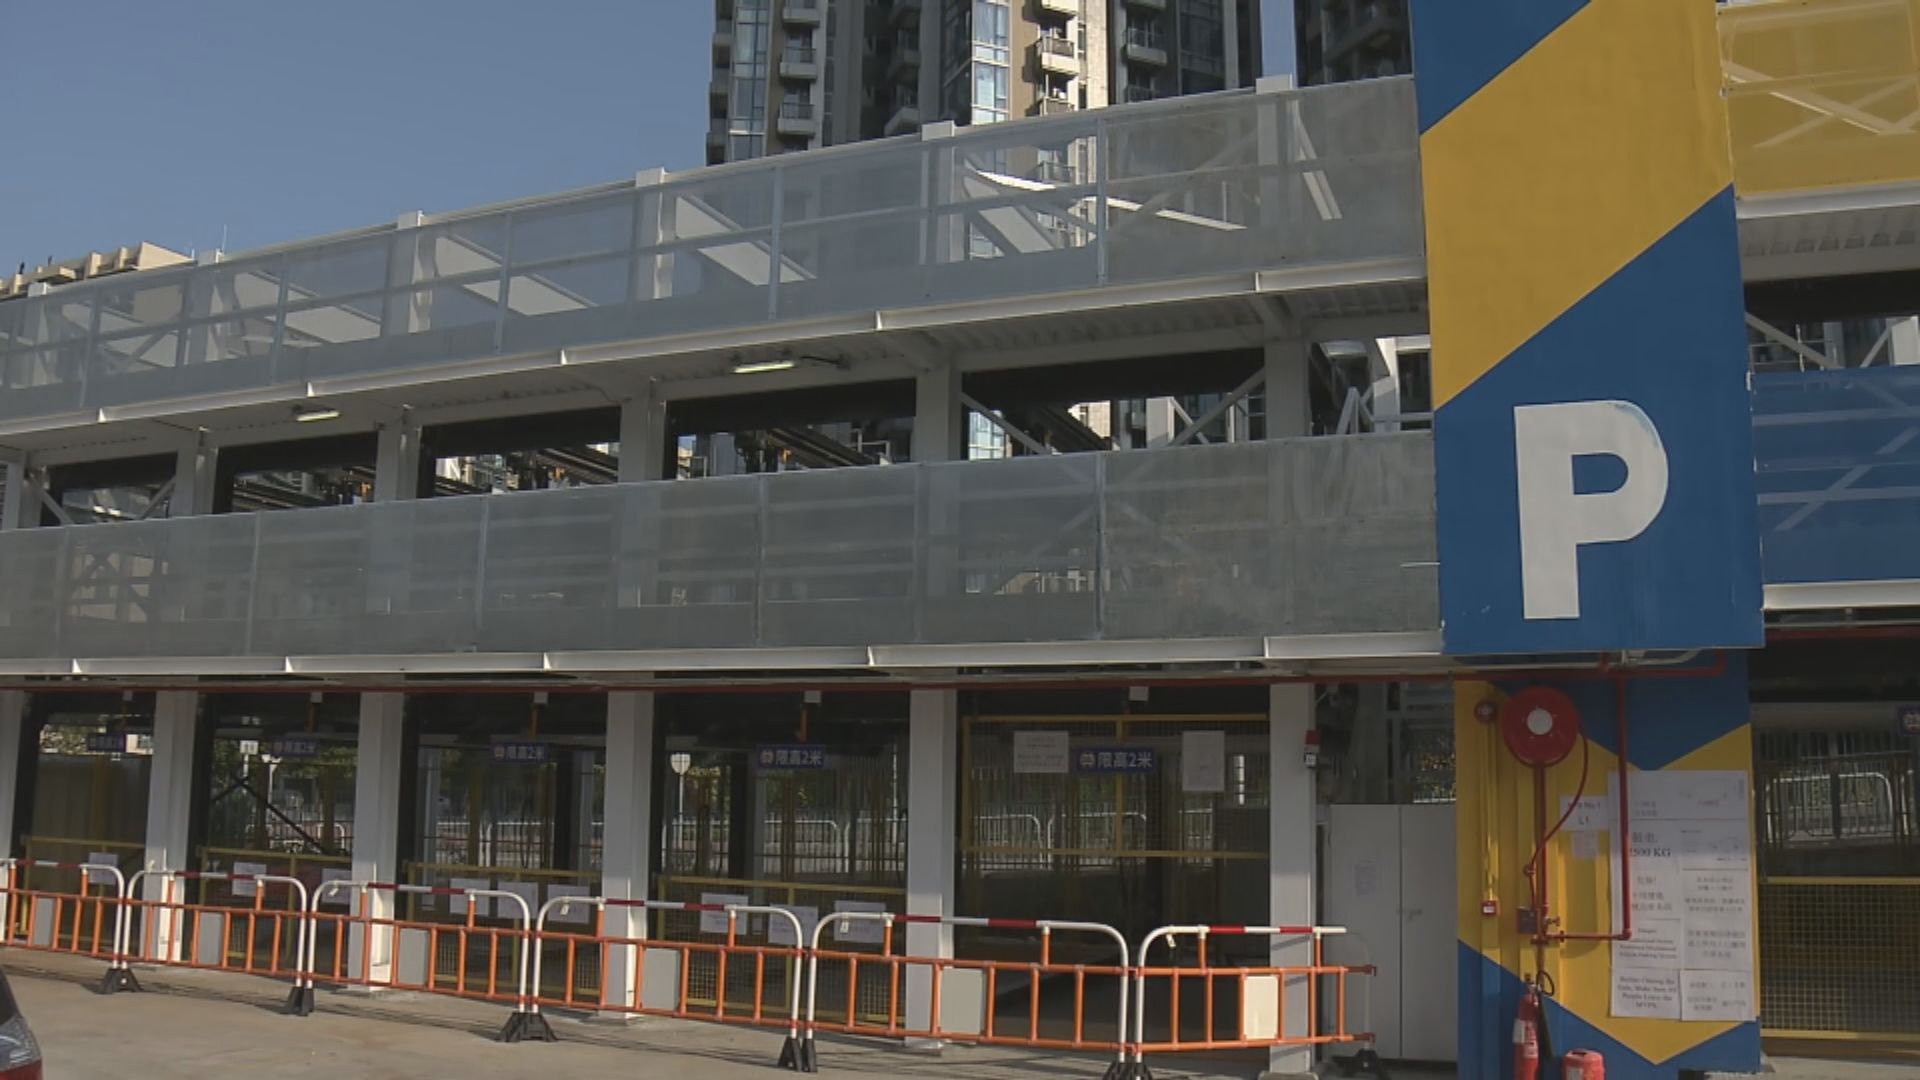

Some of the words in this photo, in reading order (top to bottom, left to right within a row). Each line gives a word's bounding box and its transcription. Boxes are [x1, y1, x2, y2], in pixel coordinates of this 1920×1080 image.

[1514, 400, 1669, 620] P
[1097, 751, 1152, 769] 限高2米
[1653, 847, 1672, 857] KG
